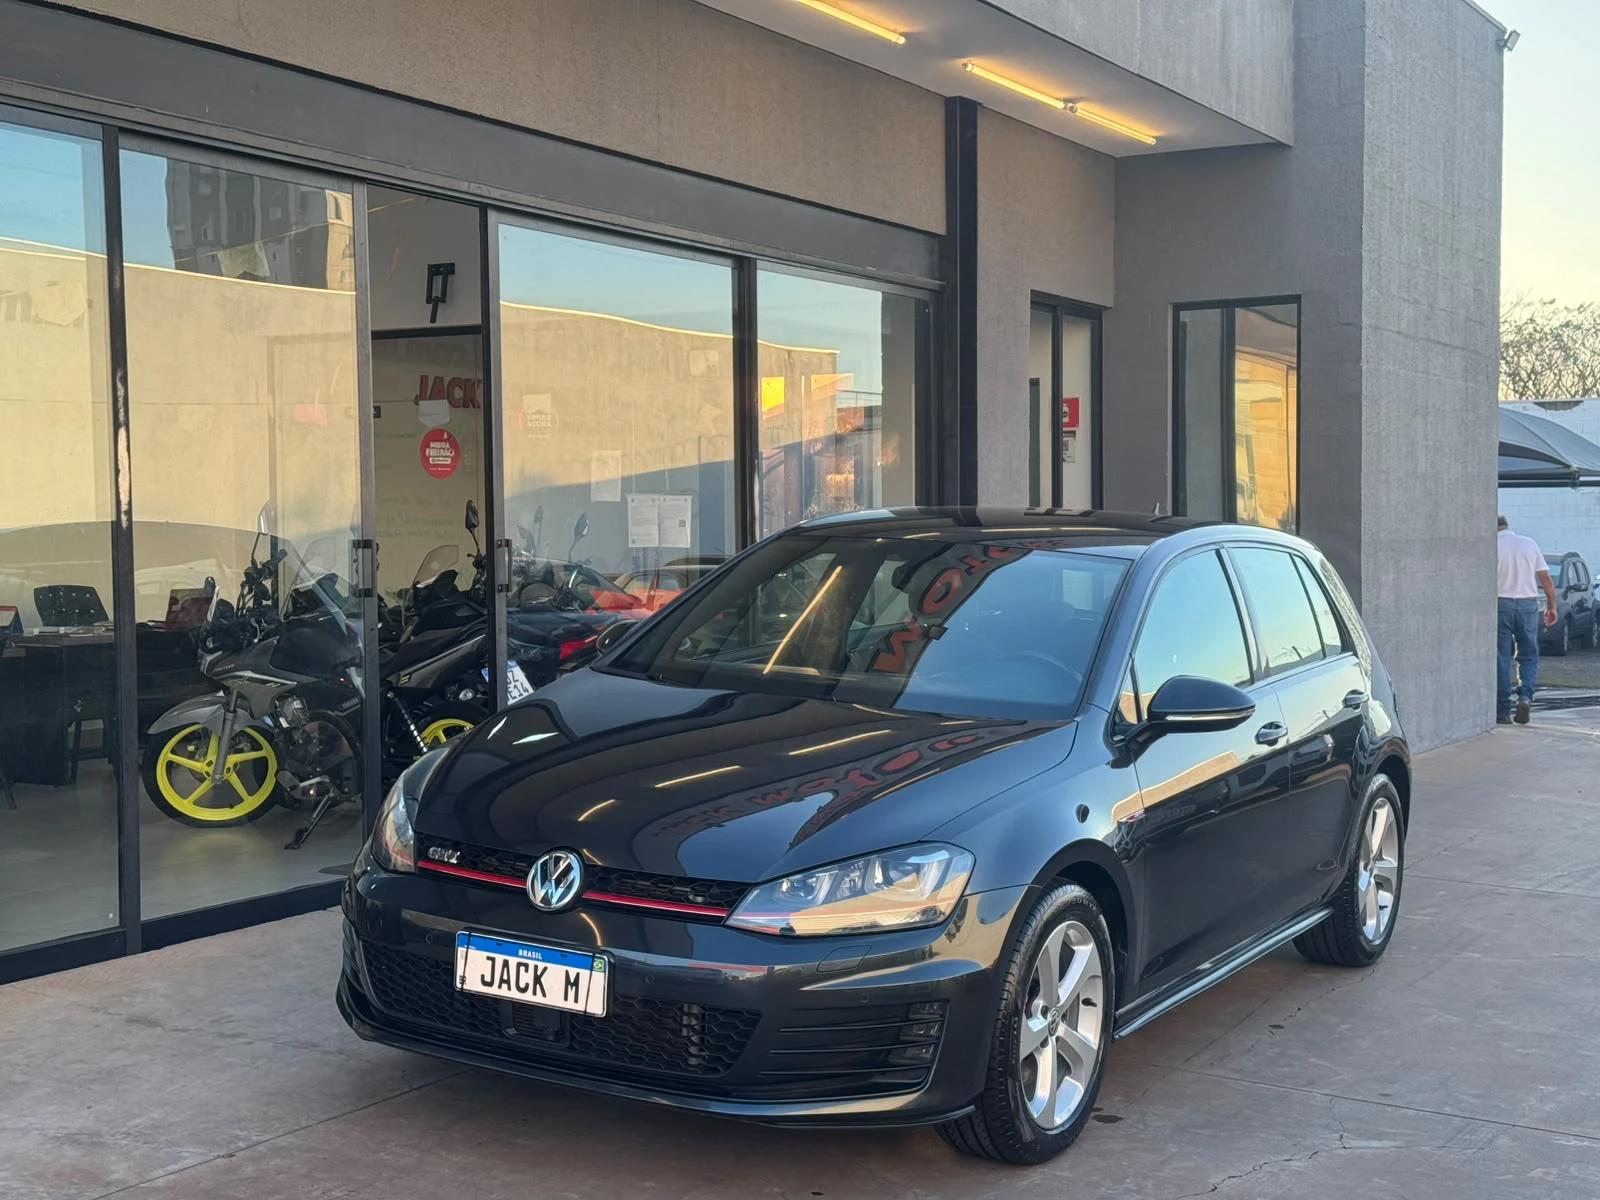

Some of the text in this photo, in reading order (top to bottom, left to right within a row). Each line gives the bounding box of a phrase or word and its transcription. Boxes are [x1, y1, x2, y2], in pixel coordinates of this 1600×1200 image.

[518, 948, 543, 960] BRASIL
[480, 955, 581, 1004] JACK M
